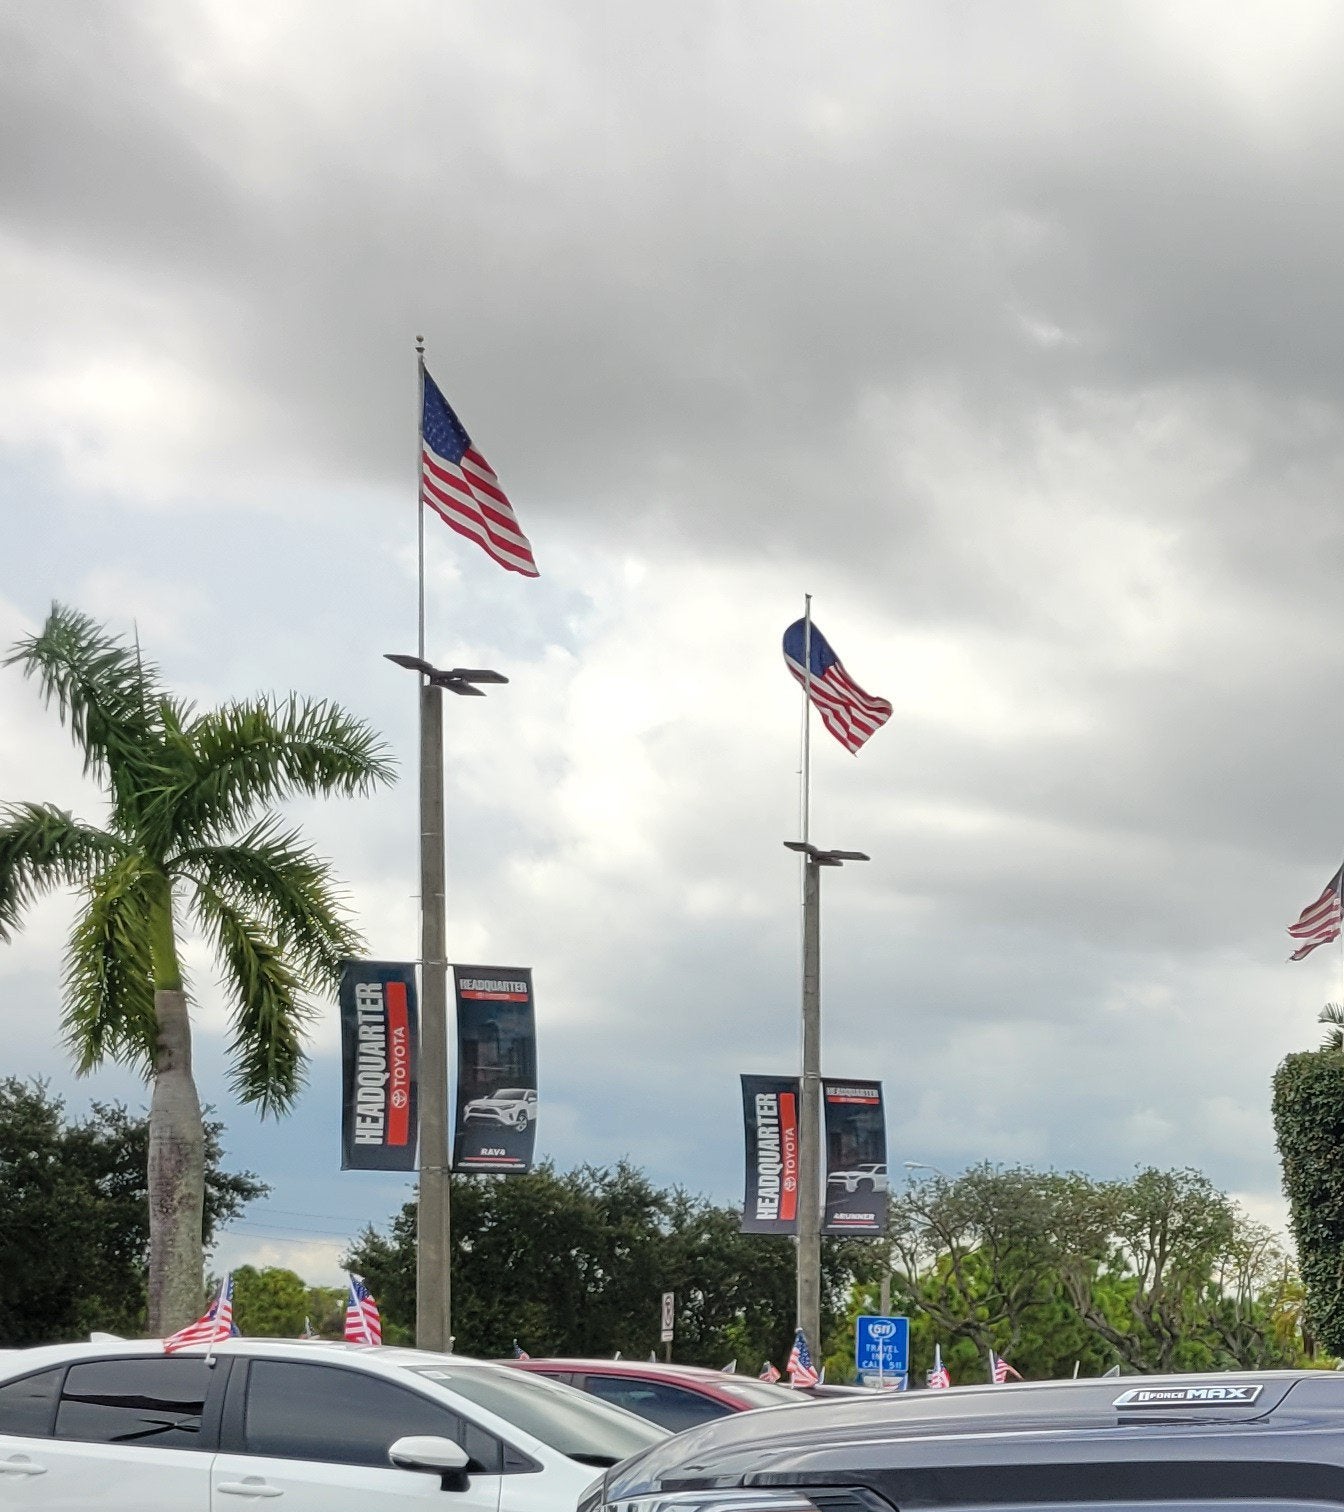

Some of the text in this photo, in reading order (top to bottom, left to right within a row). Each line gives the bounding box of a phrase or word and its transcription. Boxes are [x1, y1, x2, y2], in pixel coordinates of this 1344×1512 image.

[459, 978, 528, 993] HEADQUARTER
[354, 982, 391, 1145] HEADQUARTER
[393, 1026, 407, 1087] TOYOTA
[480, 1147, 506, 1156] RAV4
[755, 1092, 781, 1220] HEADQUARTER
[785, 1127, 796, 1177] TOYOTA
[865, 1343, 899, 1354] TRAVEL
[1186, 1388, 1248, 1399] MAX
